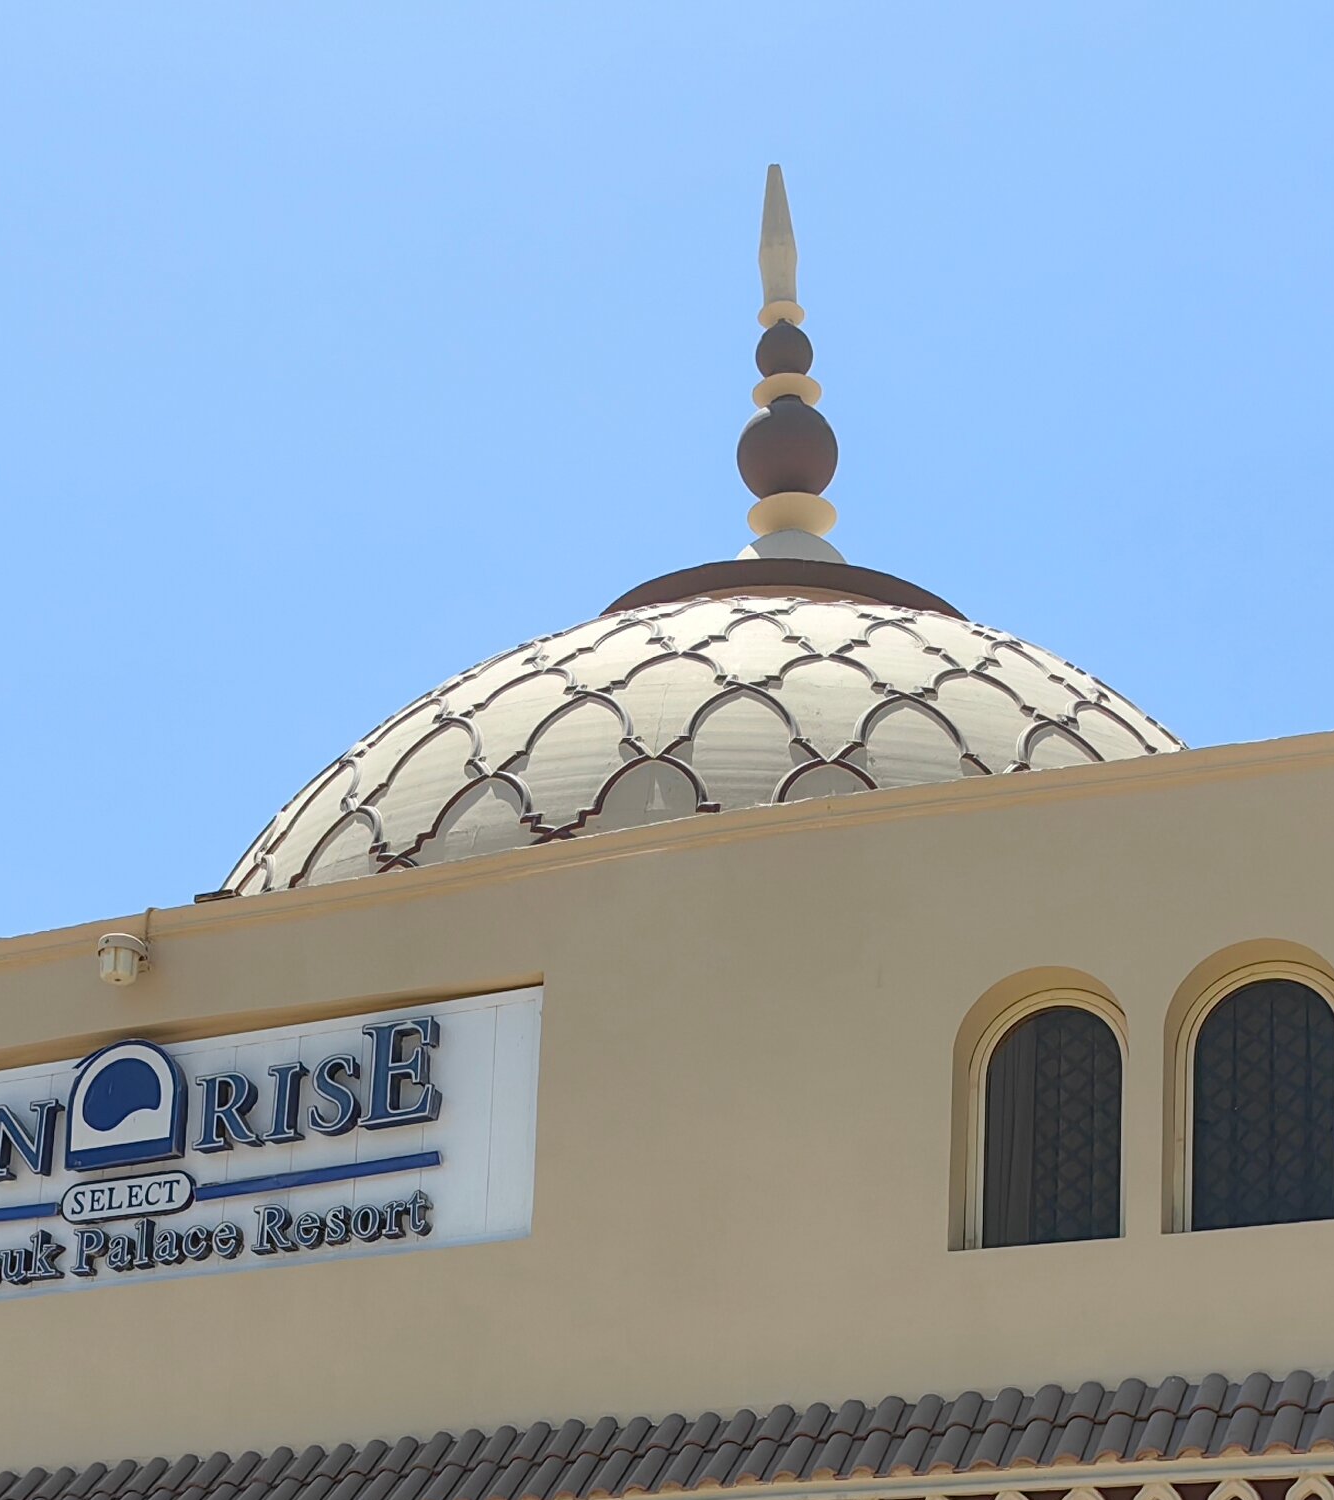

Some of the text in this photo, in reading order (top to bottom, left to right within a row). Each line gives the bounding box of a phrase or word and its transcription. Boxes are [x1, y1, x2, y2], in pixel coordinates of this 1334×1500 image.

[71, 1179, 180, 1215] SELECT
[70, 1218, 244, 1277] Palace
[251, 1190, 433, 1255] Resort
